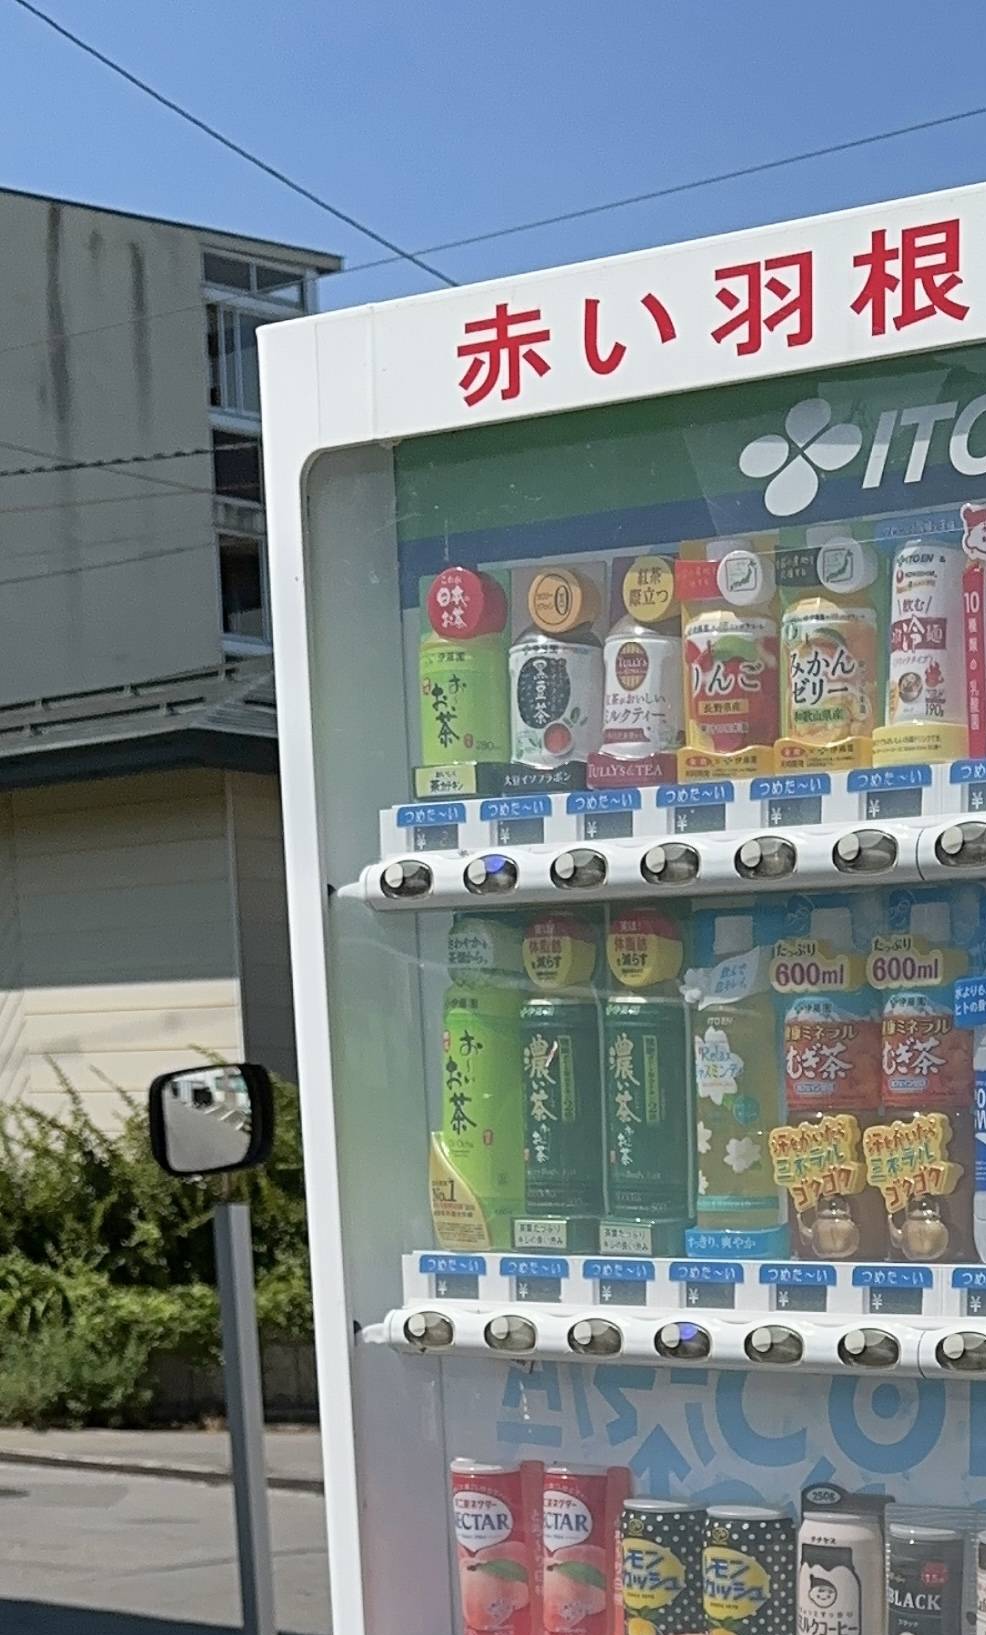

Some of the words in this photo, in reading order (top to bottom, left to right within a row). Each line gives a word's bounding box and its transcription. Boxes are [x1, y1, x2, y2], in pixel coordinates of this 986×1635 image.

[637, 567, 662, 586] 紅茶
[628, 588, 669, 607] 際立つ
[441, 607, 468, 629] お茶
[791, 651, 855, 678] みかん
[533, 659, 550, 728] 黒豆茶
[431, 683, 460, 748] お茶
[703, 701, 741, 715] 長野県産
[634, 763, 663, 777] TEA
[775, 943, 816, 957] たっぷり
[873, 937, 912, 952] たっぷり
[775, 962, 845, 986] 600ml
[872, 956, 939, 982] 600ml
[787, 1044, 852, 1080] むぎ茶
[883, 1038, 947, 1077] むぎ茶
[523, 1033, 558, 1122] 濃い茶
[608, 1032, 642, 1123] 濃い茶
[793, 1165, 857, 1207] ゴクゴク
[885, 1165, 944, 1207] ゴクゴク
[811, 1536, 837, 1545] チチヤス
[888, 1587, 941, 1611] BLACK
